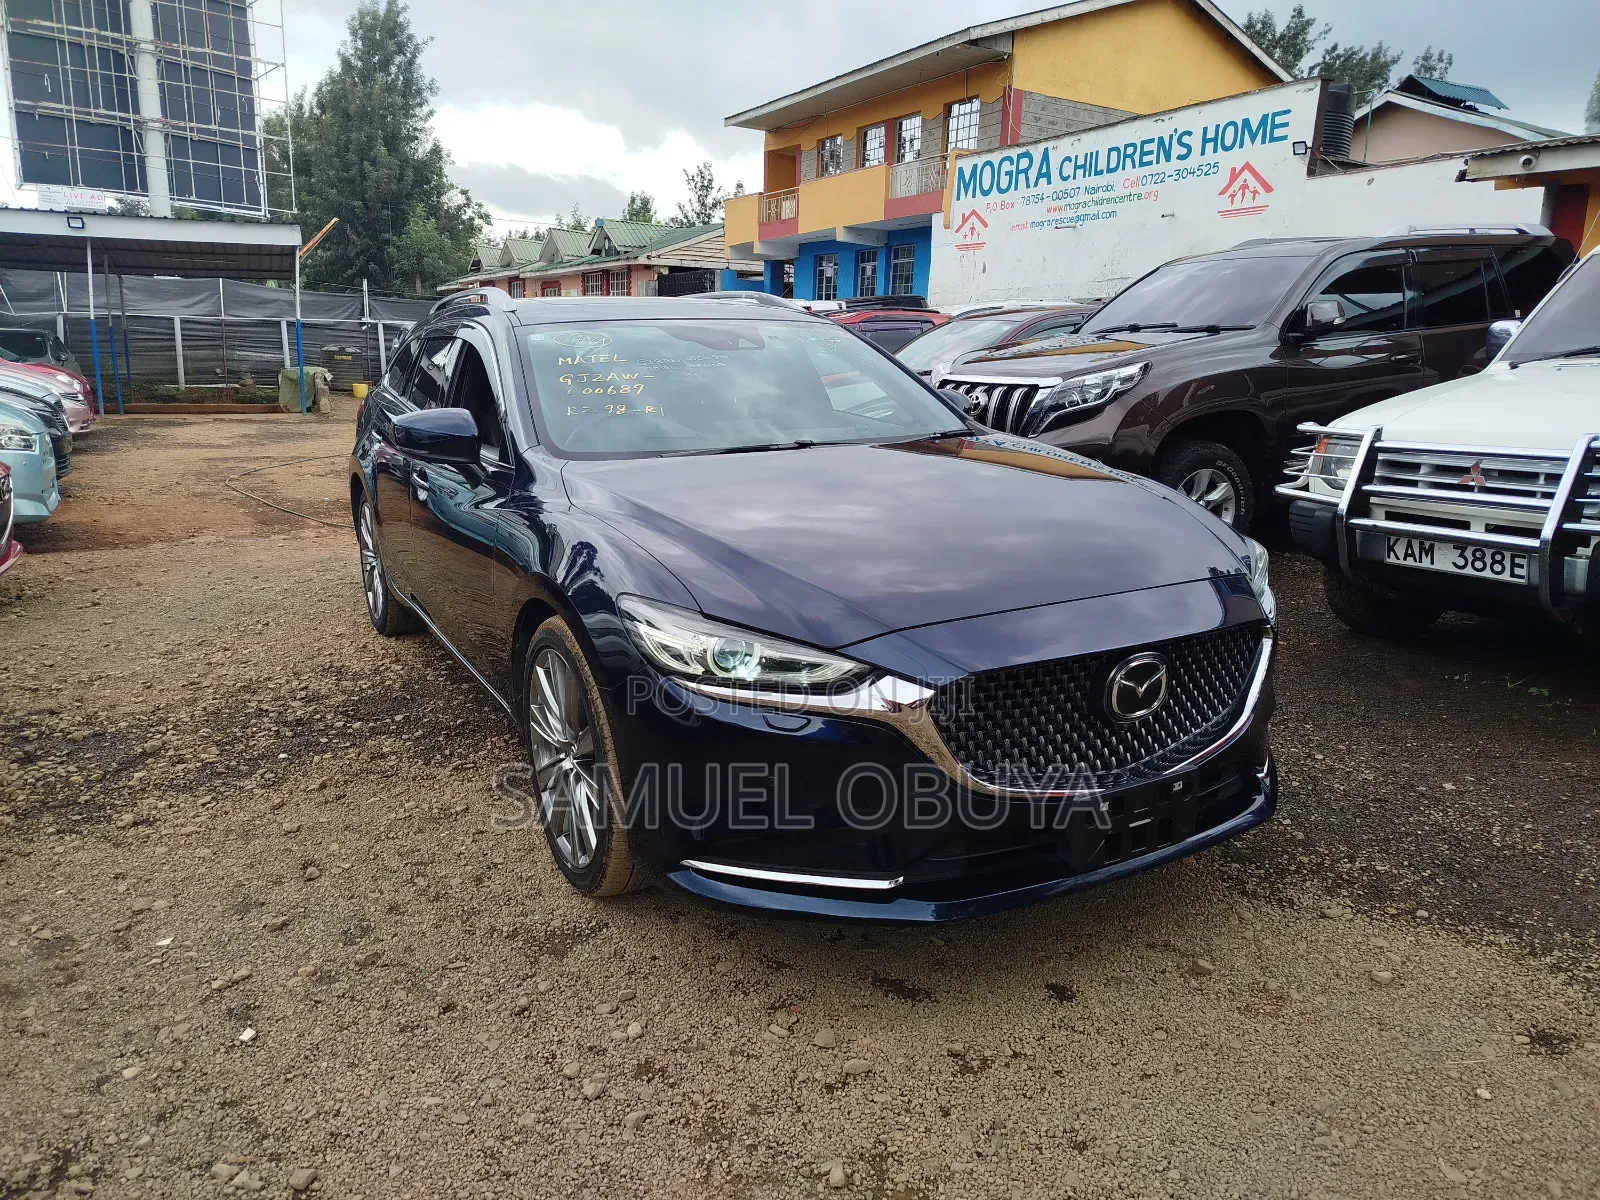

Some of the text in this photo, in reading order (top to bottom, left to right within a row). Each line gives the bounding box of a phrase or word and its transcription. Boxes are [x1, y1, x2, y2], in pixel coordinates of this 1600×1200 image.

[956, 108, 1292, 201] MOGRA CHILDREN'S HOME
[1000, 200, 1015, 210] Box
[558, 353, 628, 366] MATEL
[1385, 536, 1527, 580] KAM 388E
